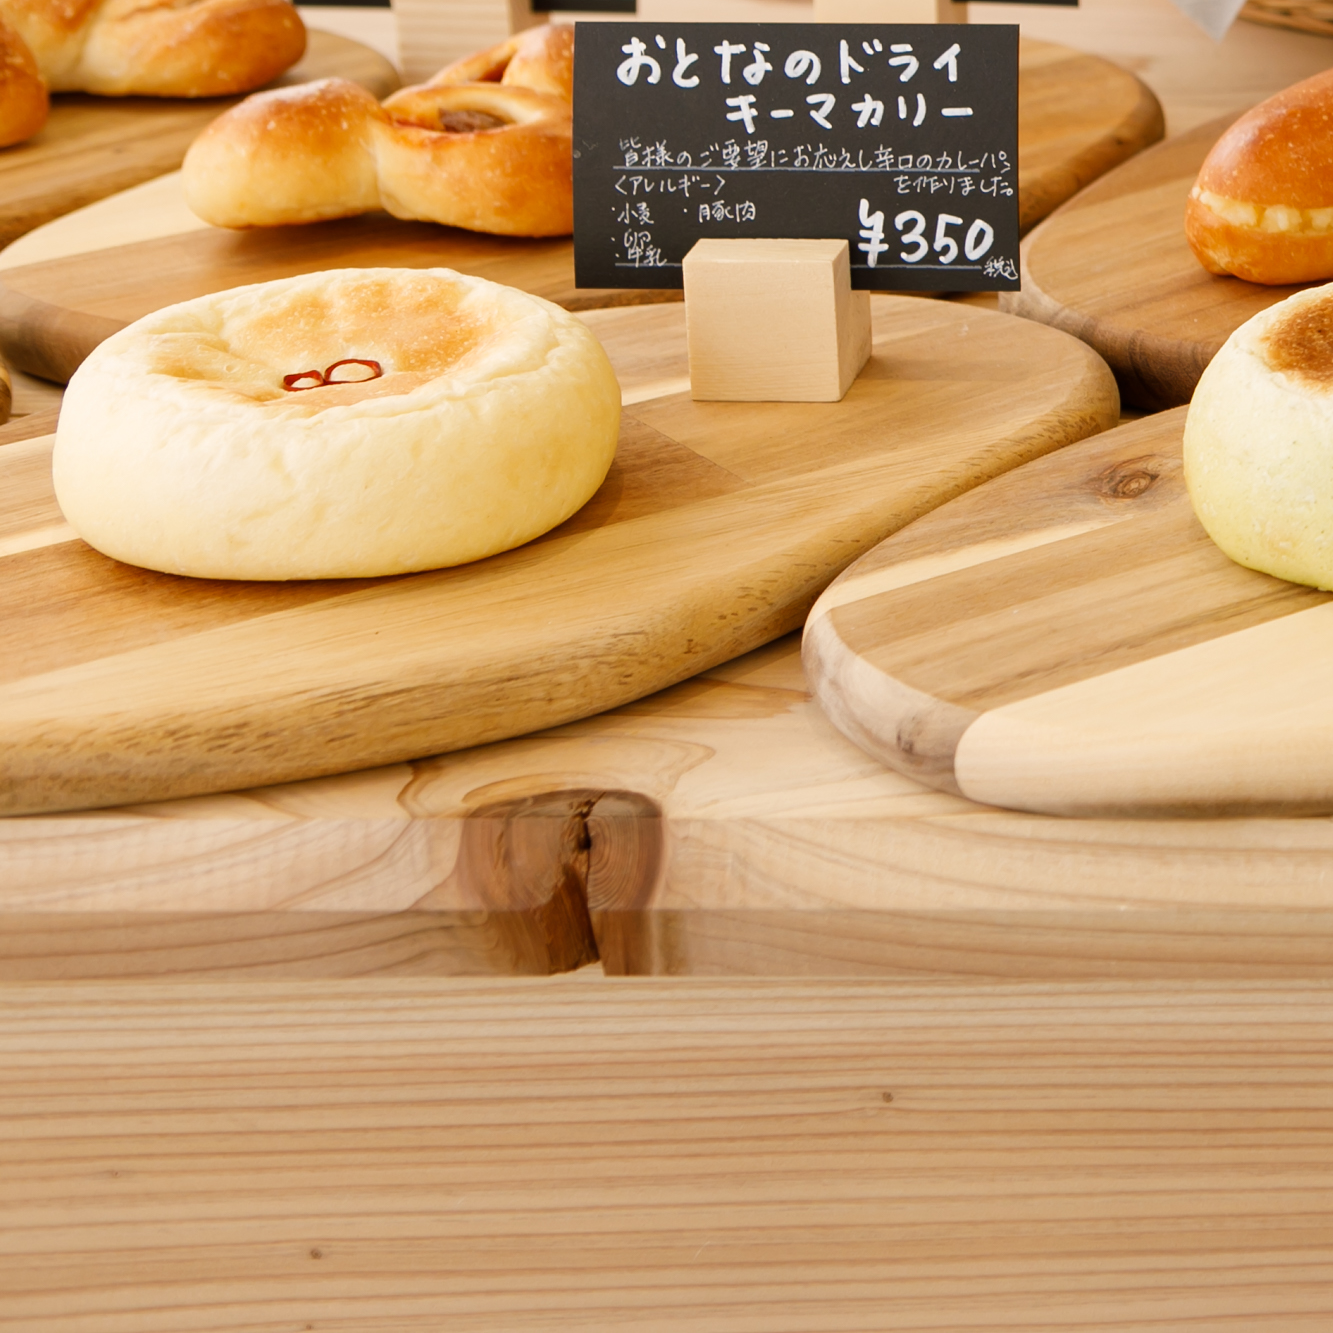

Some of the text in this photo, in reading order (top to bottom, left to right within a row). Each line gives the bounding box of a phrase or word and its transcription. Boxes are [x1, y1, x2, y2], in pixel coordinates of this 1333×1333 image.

[615, 33, 963, 89] おとなのドライ
[724, 93, 975, 134] キーマカリー
[857, 197, 995, 269] ¥350
